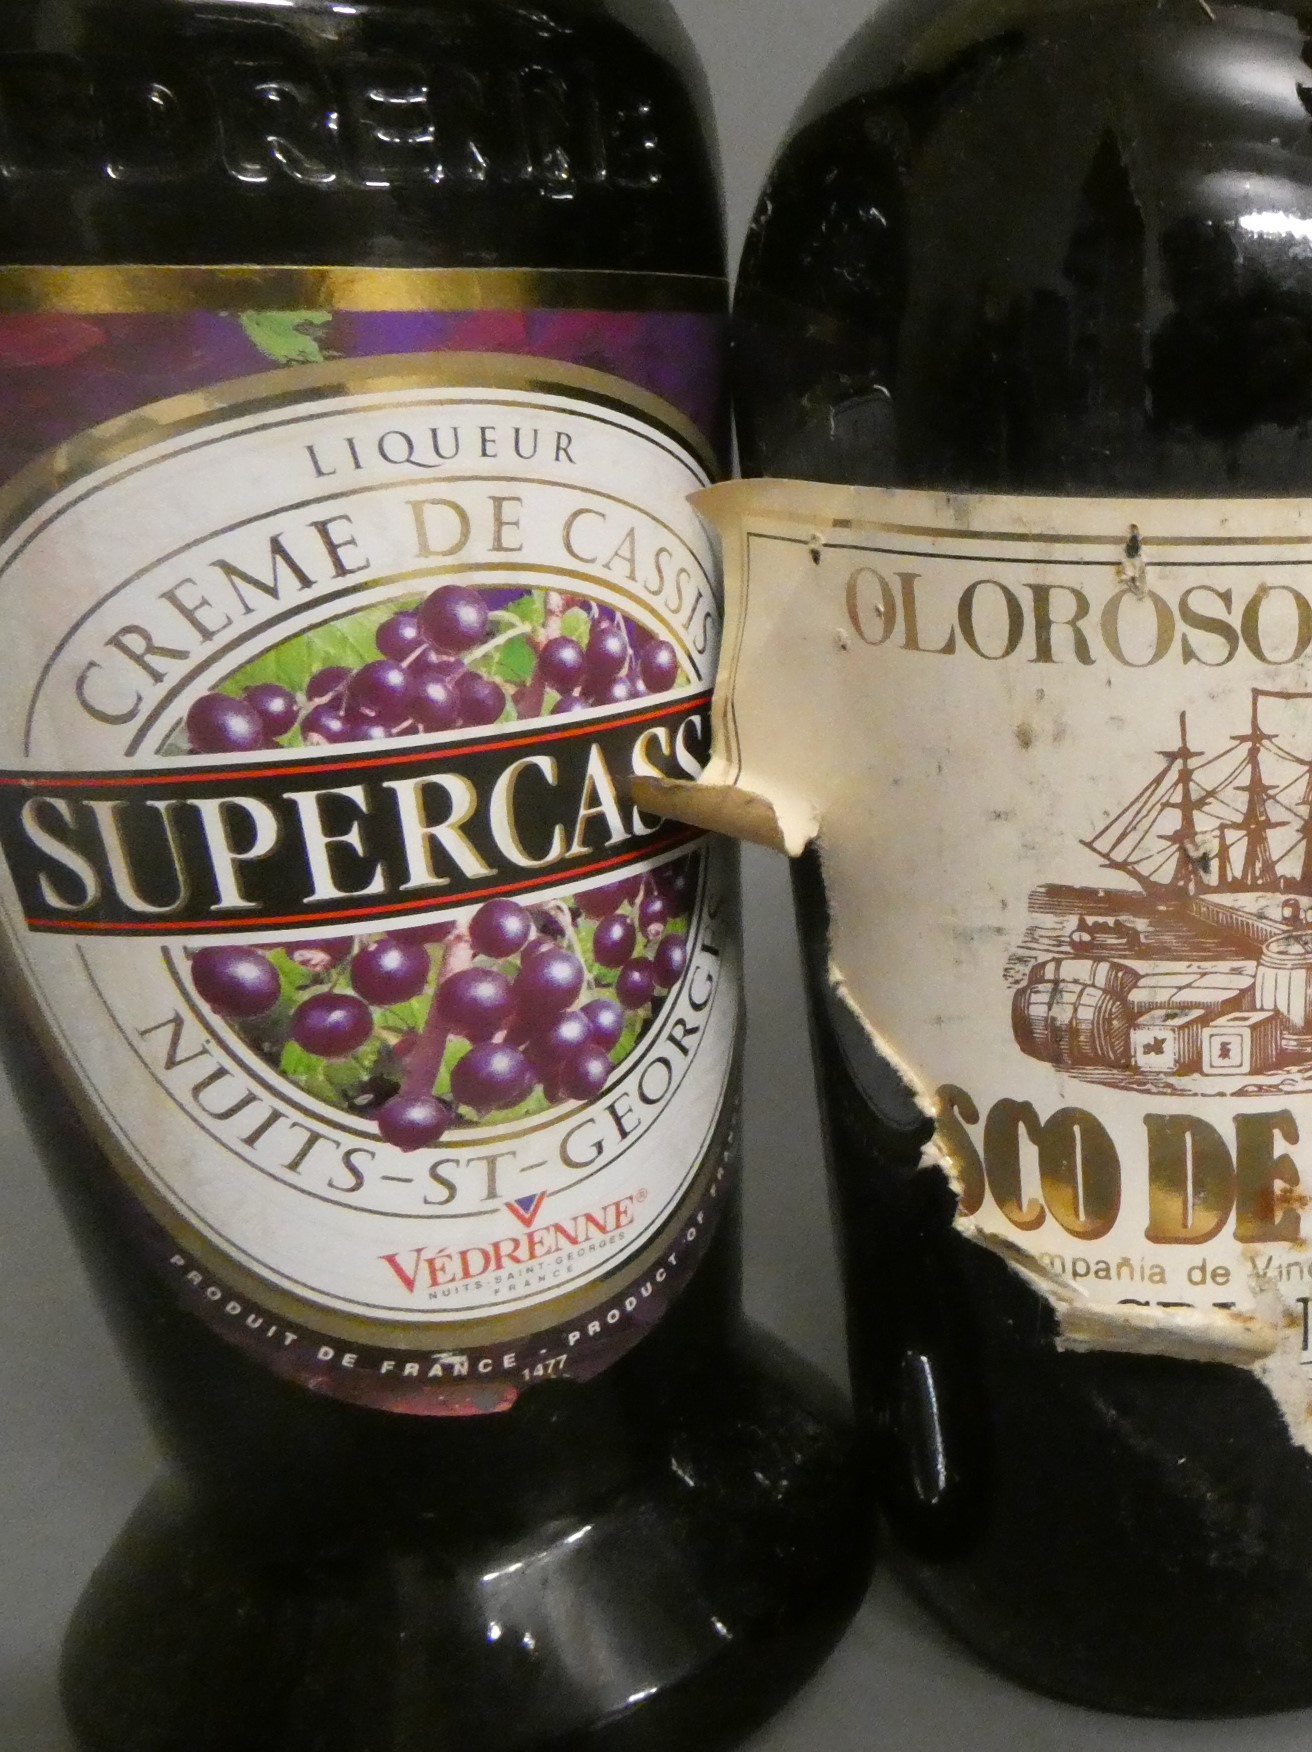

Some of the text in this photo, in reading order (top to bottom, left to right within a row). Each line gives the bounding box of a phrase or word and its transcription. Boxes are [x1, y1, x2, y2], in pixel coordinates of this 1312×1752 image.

[304, 424, 577, 479] LIQUEUR
[74, 495, 715, 727] CREME DE CASSIS
[935, 1083, 1122, 1240] SCO
[1143, 1108, 1302, 1245] DE
[494, 1263, 575, 1297] FRANCE
[1187, 1257, 1232, 1286] de
[170, 1253, 298, 1347] PRODUIT
[316, 1345, 358, 1368] DE
[380, 1353, 517, 1379] FRANCE
[567, 1252, 678, 1347] PRODUCT
[521, 1355, 569, 1382] 1477
